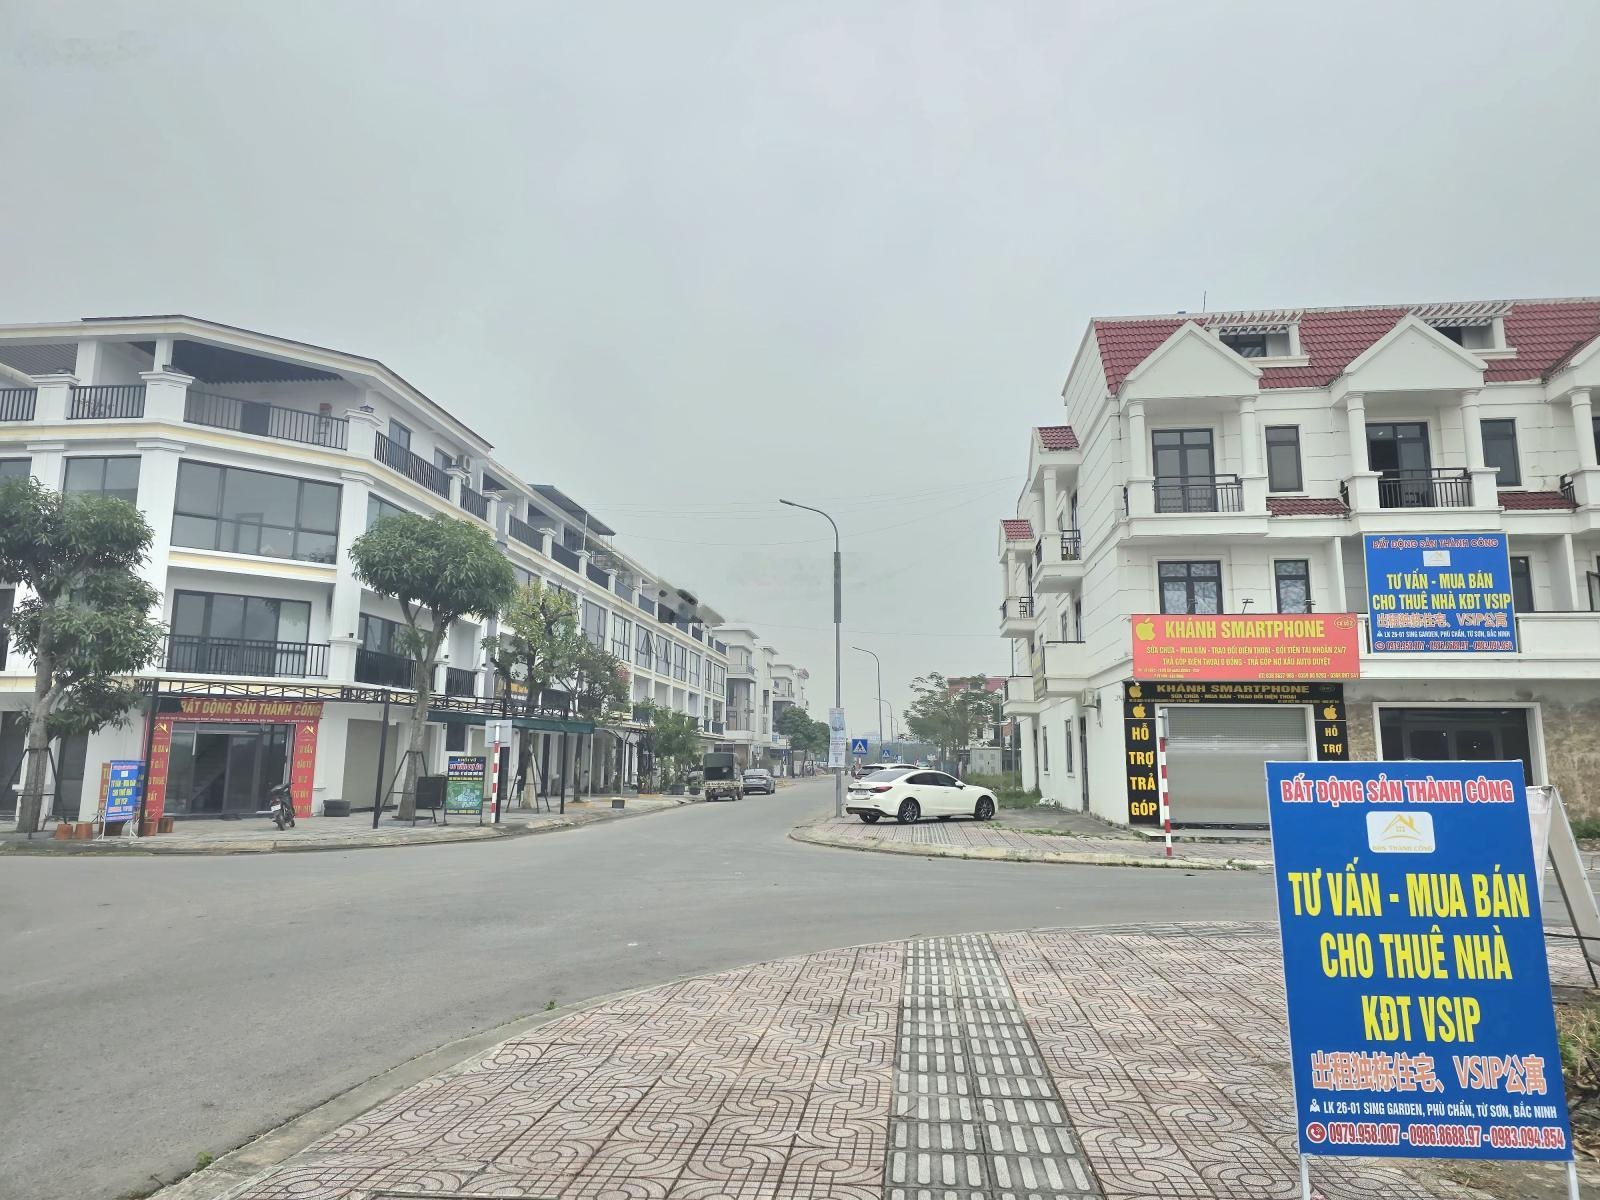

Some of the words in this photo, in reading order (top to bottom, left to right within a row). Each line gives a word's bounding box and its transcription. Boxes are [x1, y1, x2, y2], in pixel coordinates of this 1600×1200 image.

[1391, 538, 1418, 550] ĐỘNG
[1420, 537, 1438, 548] SẢN
[1440, 537, 1469, 548] THÀNH
[1471, 537, 1499, 548] CÔNG
[1386, 572, 1402, 589] TƯ
[1404, 568, 1428, 589] VẤN
[1439, 573, 1466, 589] MUA
[1468, 570, 1493, 589] BÁN
[1372, 594, 1396, 610] CHO
[1399, 591, 1428, 610] THUÊ
[1431, 591, 1456, 610] NHÀ
[1459, 594, 1480, 610] KĐT
[1484, 594, 1511, 609] VSIP
[1165, 617, 1217, 638] KHÁNH
[1221, 620, 1326, 639] SMARTPHONE
[1156, 684, 1206, 693] KHÁNH
[1211, 684, 1310, 693] SMARTPHONE
[202, 699, 231, 716] ĐỘNG
[235, 699, 257, 714] SẢN
[259, 700, 292, 715] THÀNH
[294, 702, 321, 717] CÔNG
[1131, 722, 1149, 740] HỖ
[1323, 743, 1342, 756] TRỢ
[1128, 751, 1154, 768] TRỢ
[1129, 772, 1157, 790] TRẢ
[1280, 773, 1313, 803] BẤT
[1316, 775, 1364, 807] ĐỘNG
[1366, 772, 1404, 803] SẢN
[1405, 775, 1463, 804] THÀNH
[1465, 777, 1514, 804] CÔNG
[1131, 799, 1157, 816] GÓP
[1288, 867, 1322, 917] TƯ
[1326, 857, 1382, 917] VẤN
[1389, 893, 1399, 903] -
[1405, 873, 1468, 918] MUA
[1471, 864, 1530, 918] BÁN
[1320, 932, 1374, 978] CHO
[1378, 924, 1449, 979] THUÊ
[1452, 924, 1513, 980] NHÀ
[1361, 995, 1412, 1041] KĐT
[1418, 996, 1481, 1043] VSIP
[1323, 1101, 1335, 1114] LK
[1336, 1101, 1361, 1114] 26-01
[1363, 1102, 1385, 1115] SING
[1387, 1103, 1426, 1117] GARDEN,
[1427, 1101, 1445, 1116] PHÙ
[1476, 1101, 1489, 1117] TỪ
[1489, 1103, 1512, 1119] SƠN,
[1513, 1101, 1533, 1118] BẮC
[1534, 1105, 1557, 1119] NINH
[1328, 1121, 1401, 1145] 0979.958.007
[1409, 1123, 1482, 1147] 0986.8688.97
[1489, 1125, 1566, 1149] 0983.094.854
